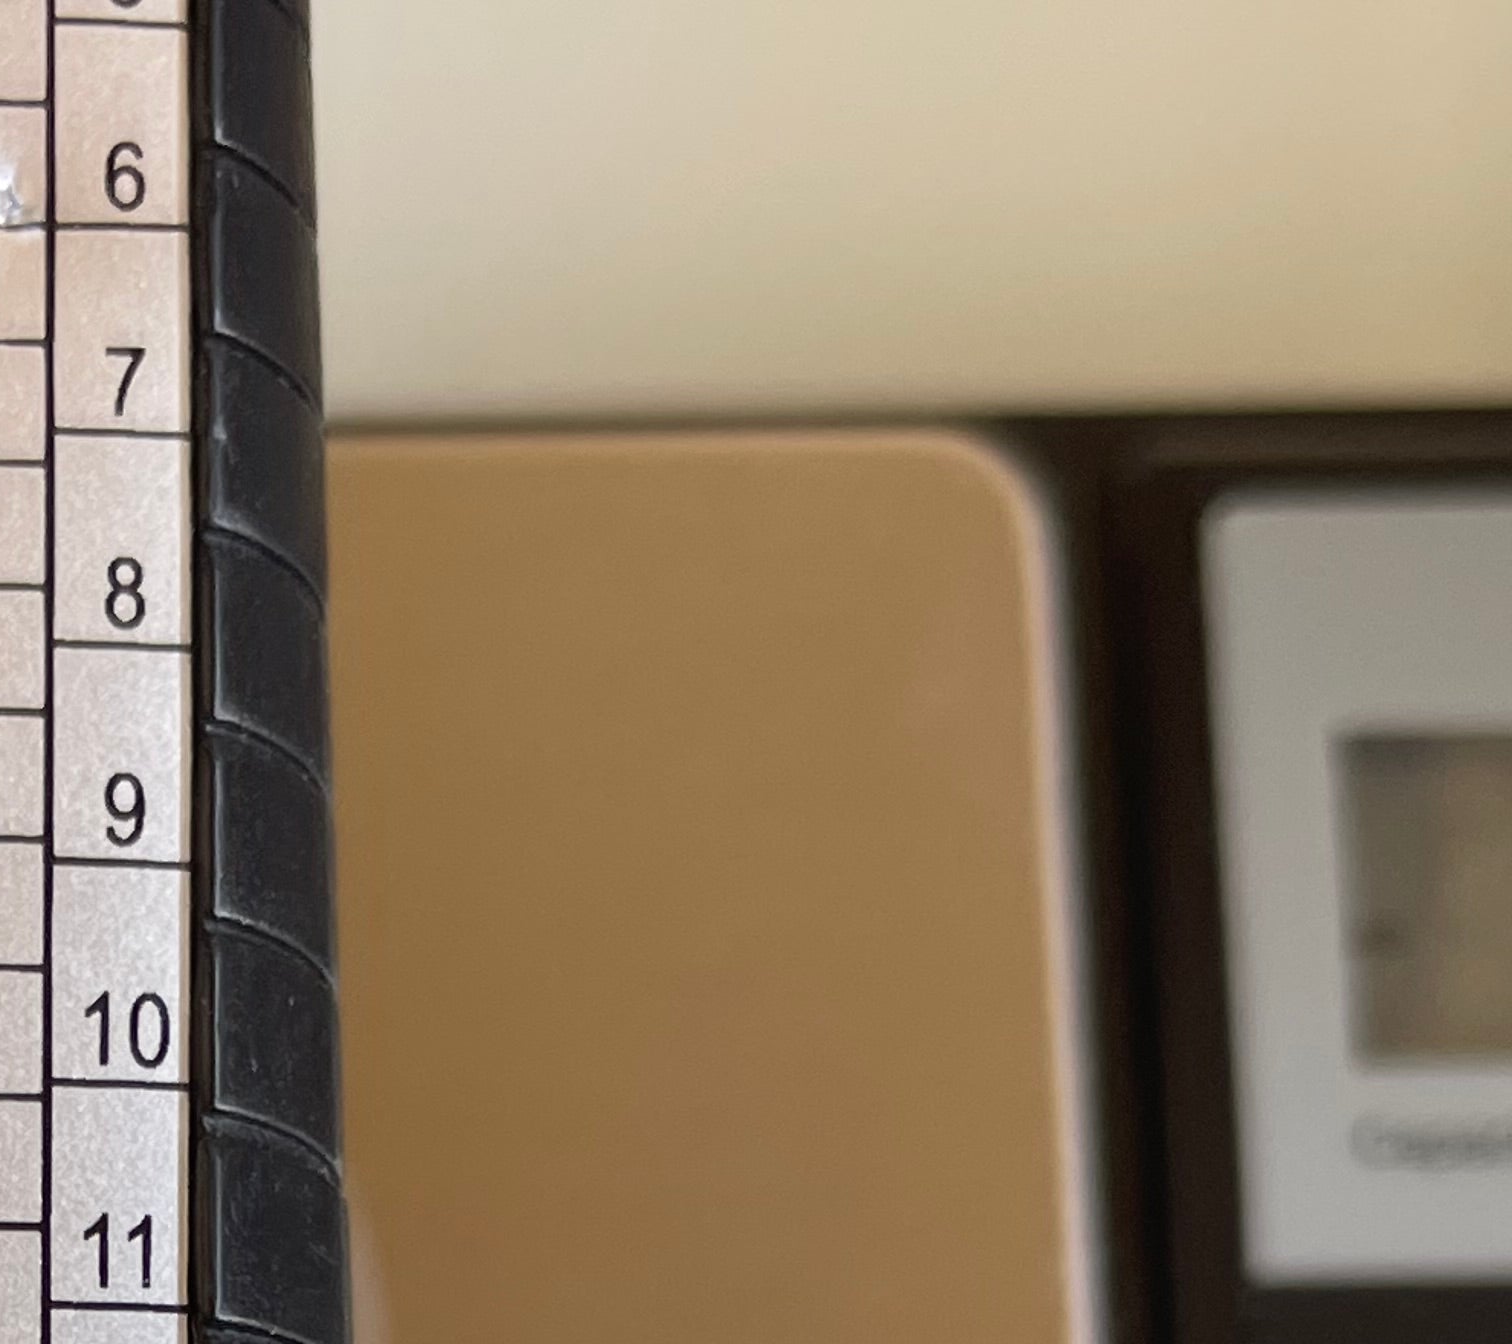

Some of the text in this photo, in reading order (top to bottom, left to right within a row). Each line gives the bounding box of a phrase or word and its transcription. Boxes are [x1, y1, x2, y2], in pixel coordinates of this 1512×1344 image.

[106, 142, 145, 210] 6
[106, 348, 145, 415] 7
[106, 557, 145, 628] 8
[105, 773, 145, 846] 9
[86, 991, 169, 1068] 10
[84, 1213, 151, 1288] 11
